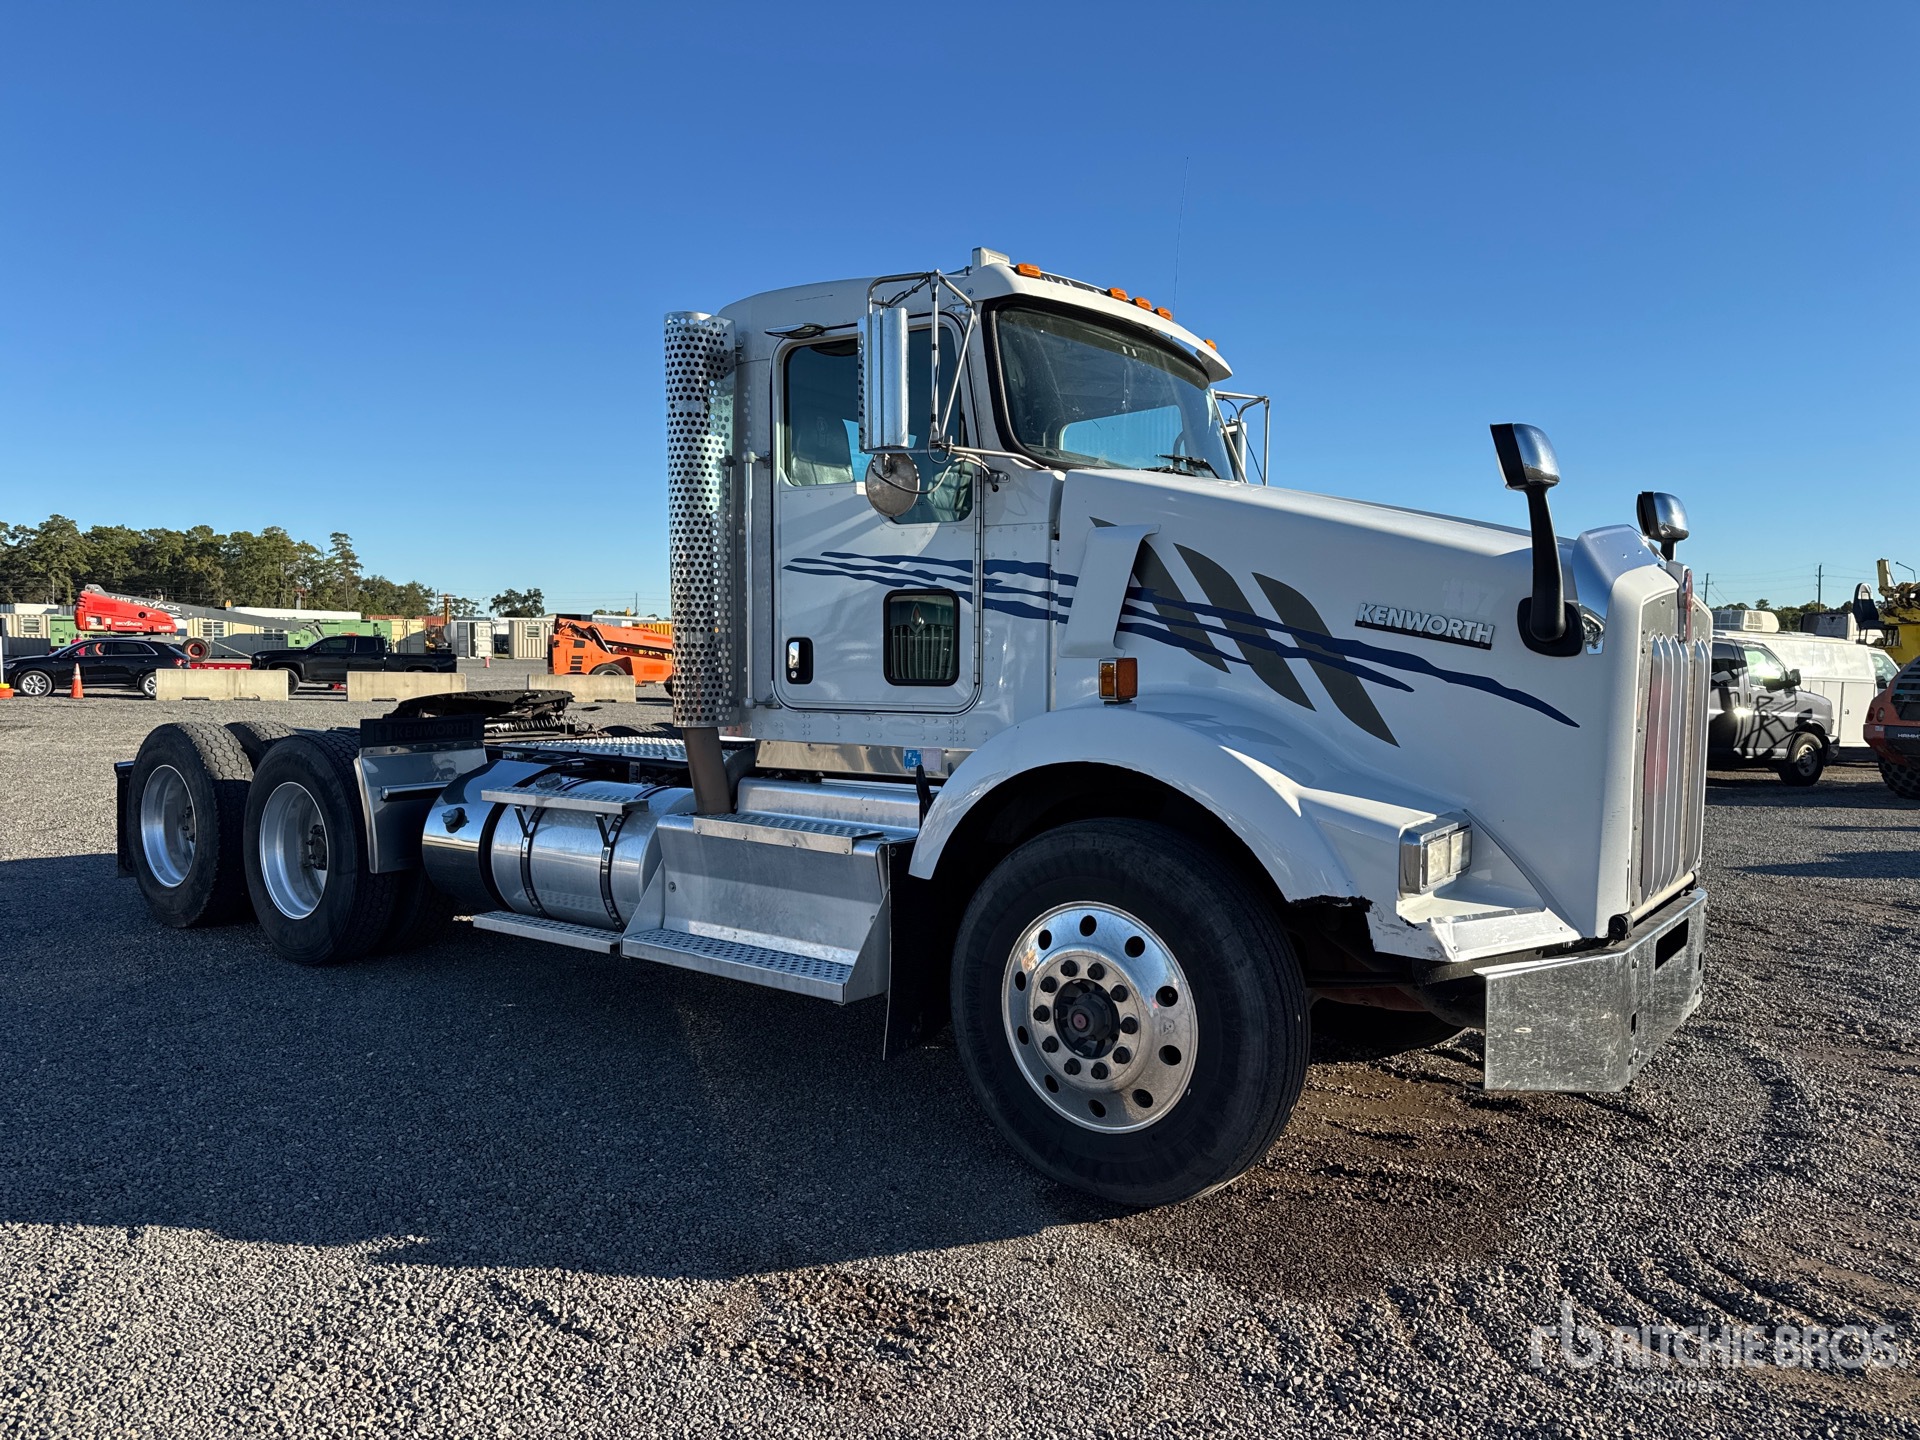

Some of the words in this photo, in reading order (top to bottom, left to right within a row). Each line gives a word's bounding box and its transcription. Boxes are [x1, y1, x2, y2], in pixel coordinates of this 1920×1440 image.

[133, 600, 181, 612] SKYJACK
[1357, 603, 1495, 644] KENWORTH
[393, 722, 470, 738] KENWORTH
[965, 960, 1026, 1130] YOKOHAMA
